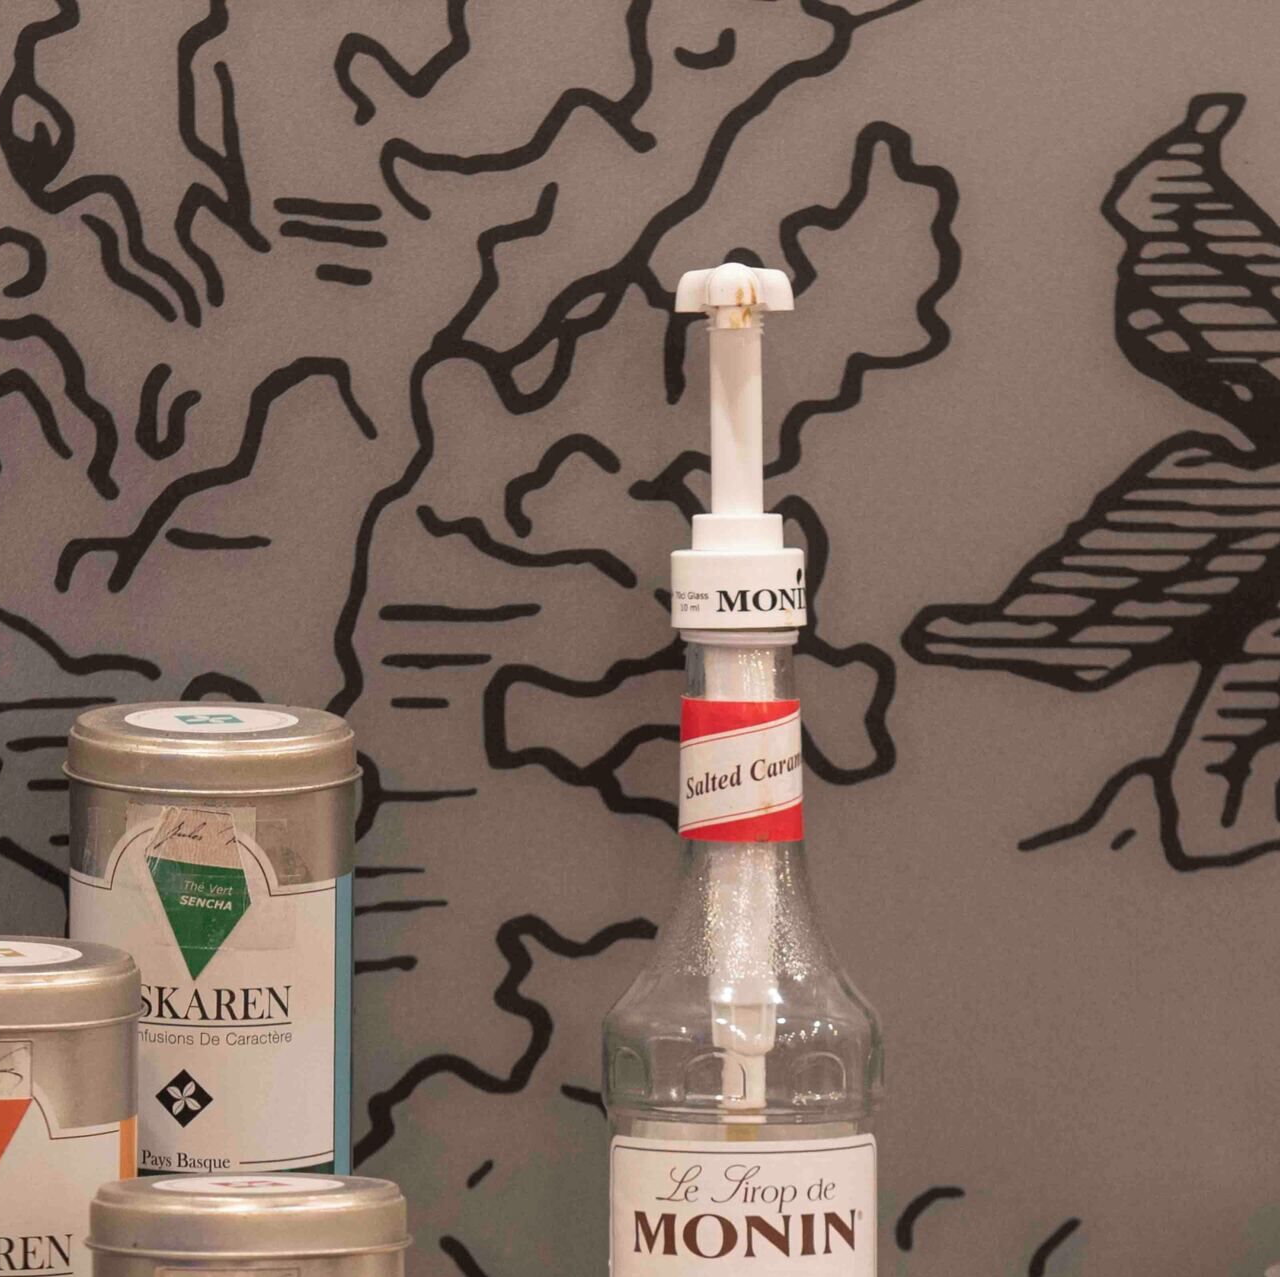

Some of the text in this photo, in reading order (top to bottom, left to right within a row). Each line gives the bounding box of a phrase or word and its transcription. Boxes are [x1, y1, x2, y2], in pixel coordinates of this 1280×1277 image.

[716, 588, 806, 612] MONI
[686, 752, 800, 799] Salted Caram
[184, 880, 233, 896] Thé Vert
[180, 895, 233, 911] SENCHA
[140, 984, 292, 1020] SKAREN
[138, 1030, 292, 1046] nfusions De Caractère
[142, 1150, 230, 1173] Pays Basque
[656, 1164, 836, 1213] Le Sirop de
[634, 1209, 856, 1258] MONIN
